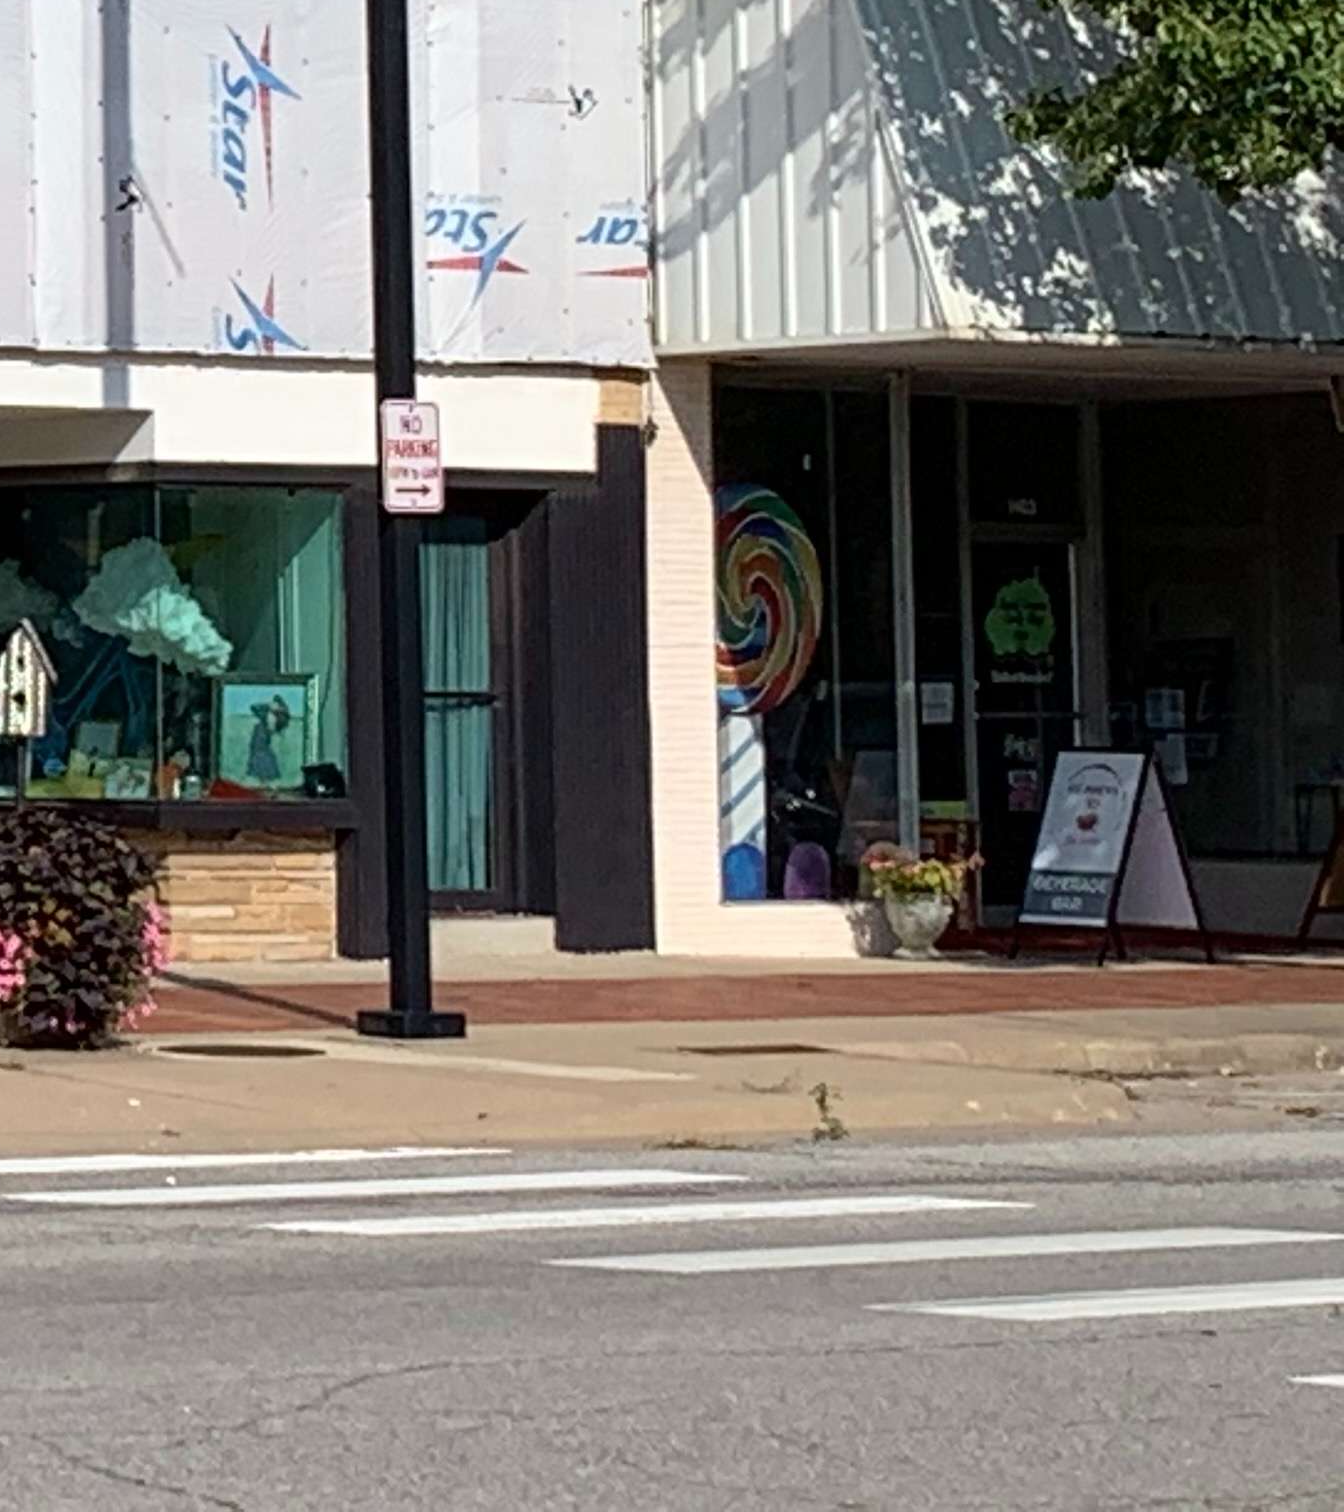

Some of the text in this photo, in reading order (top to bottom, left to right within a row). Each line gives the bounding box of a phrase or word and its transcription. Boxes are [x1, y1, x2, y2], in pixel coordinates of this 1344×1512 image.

[221, 60, 257, 211] Star
[400, 414, 422, 434] NO
[386, 439, 438, 458] PARKING
[1051, 896, 1083, 911] BAR
